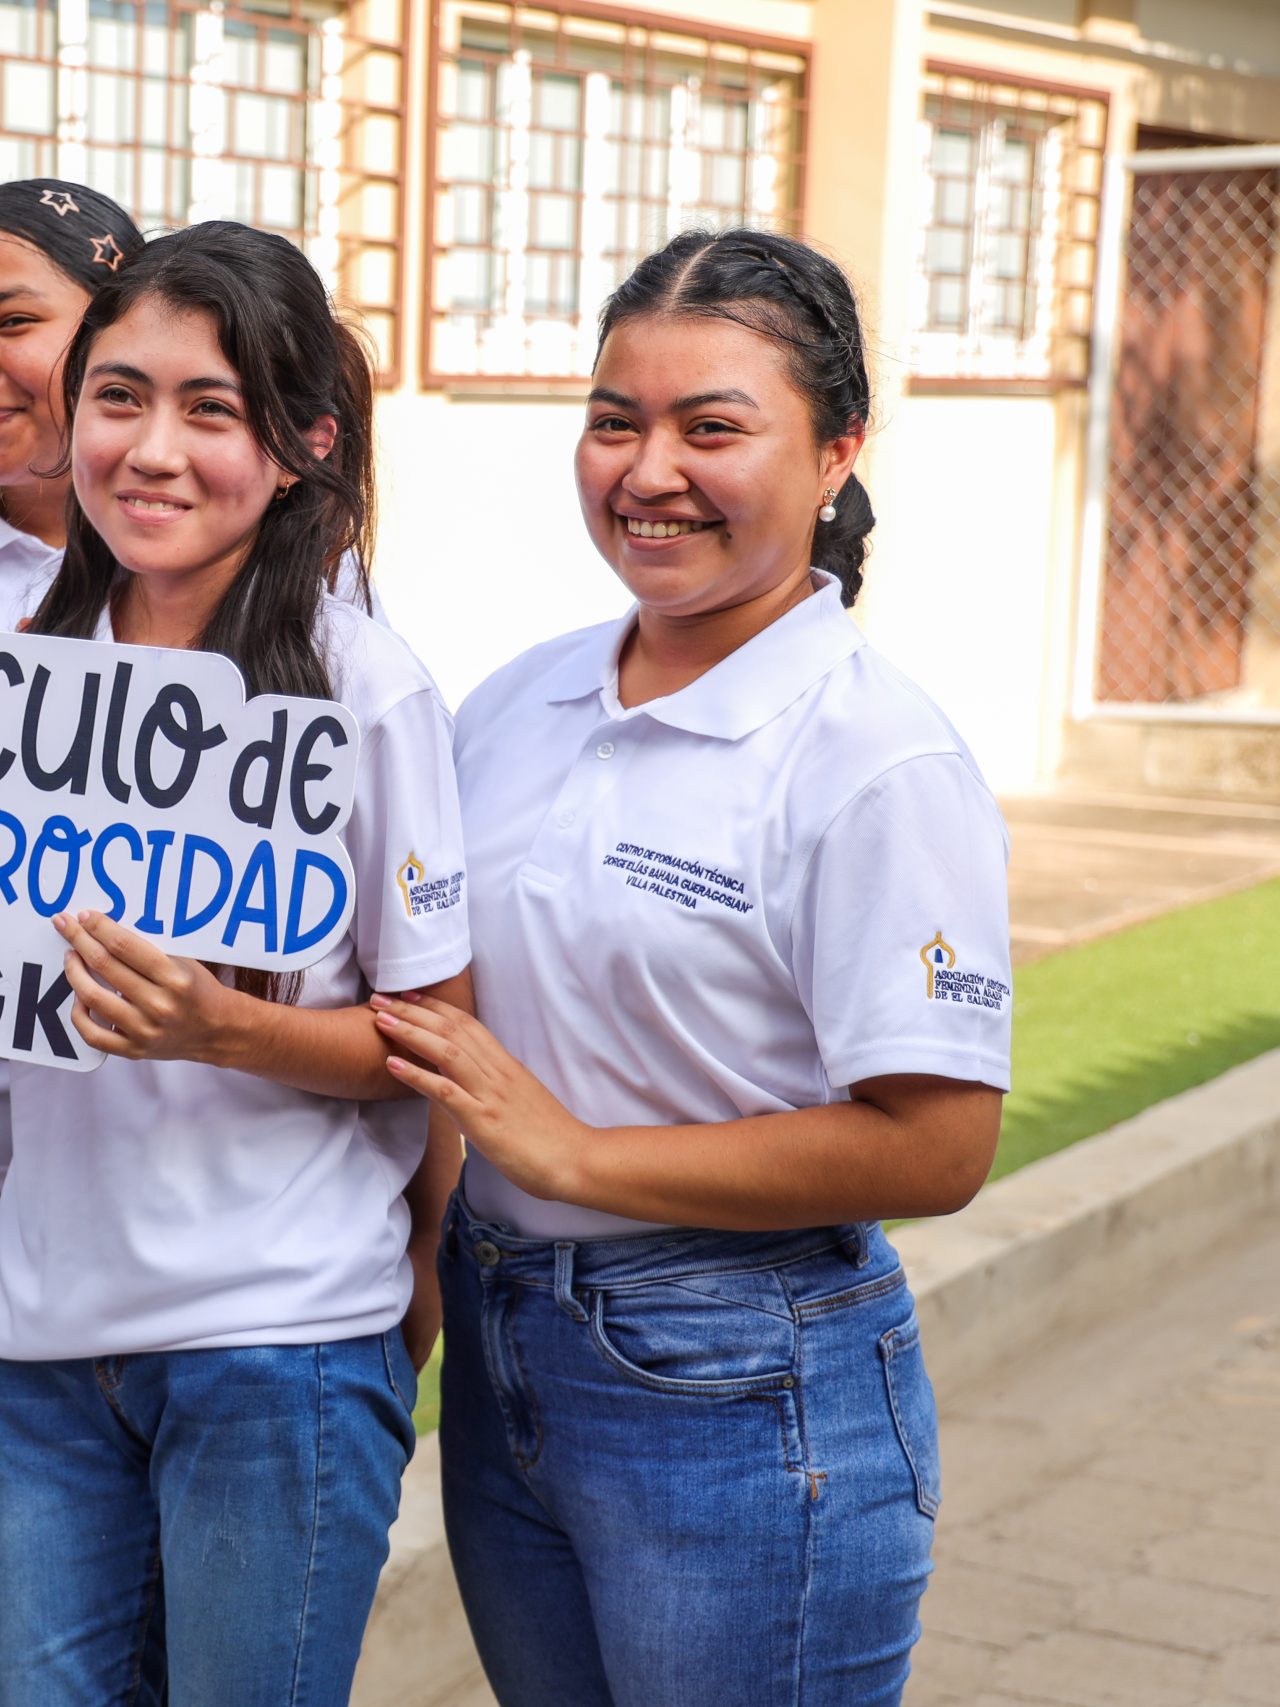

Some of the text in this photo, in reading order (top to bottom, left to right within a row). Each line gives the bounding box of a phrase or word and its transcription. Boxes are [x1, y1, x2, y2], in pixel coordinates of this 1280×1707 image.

[616, 842, 745, 894] CENTRO DE FORMACIÓN TÉCNICA
[626, 875, 697, 910] VILLA PALESTINA
[934, 970, 984, 985] ASOCIACIÓN
[934, 980, 980, 995] FEMENINA
[934, 990, 1001, 1010] DE EL SALVADOR
